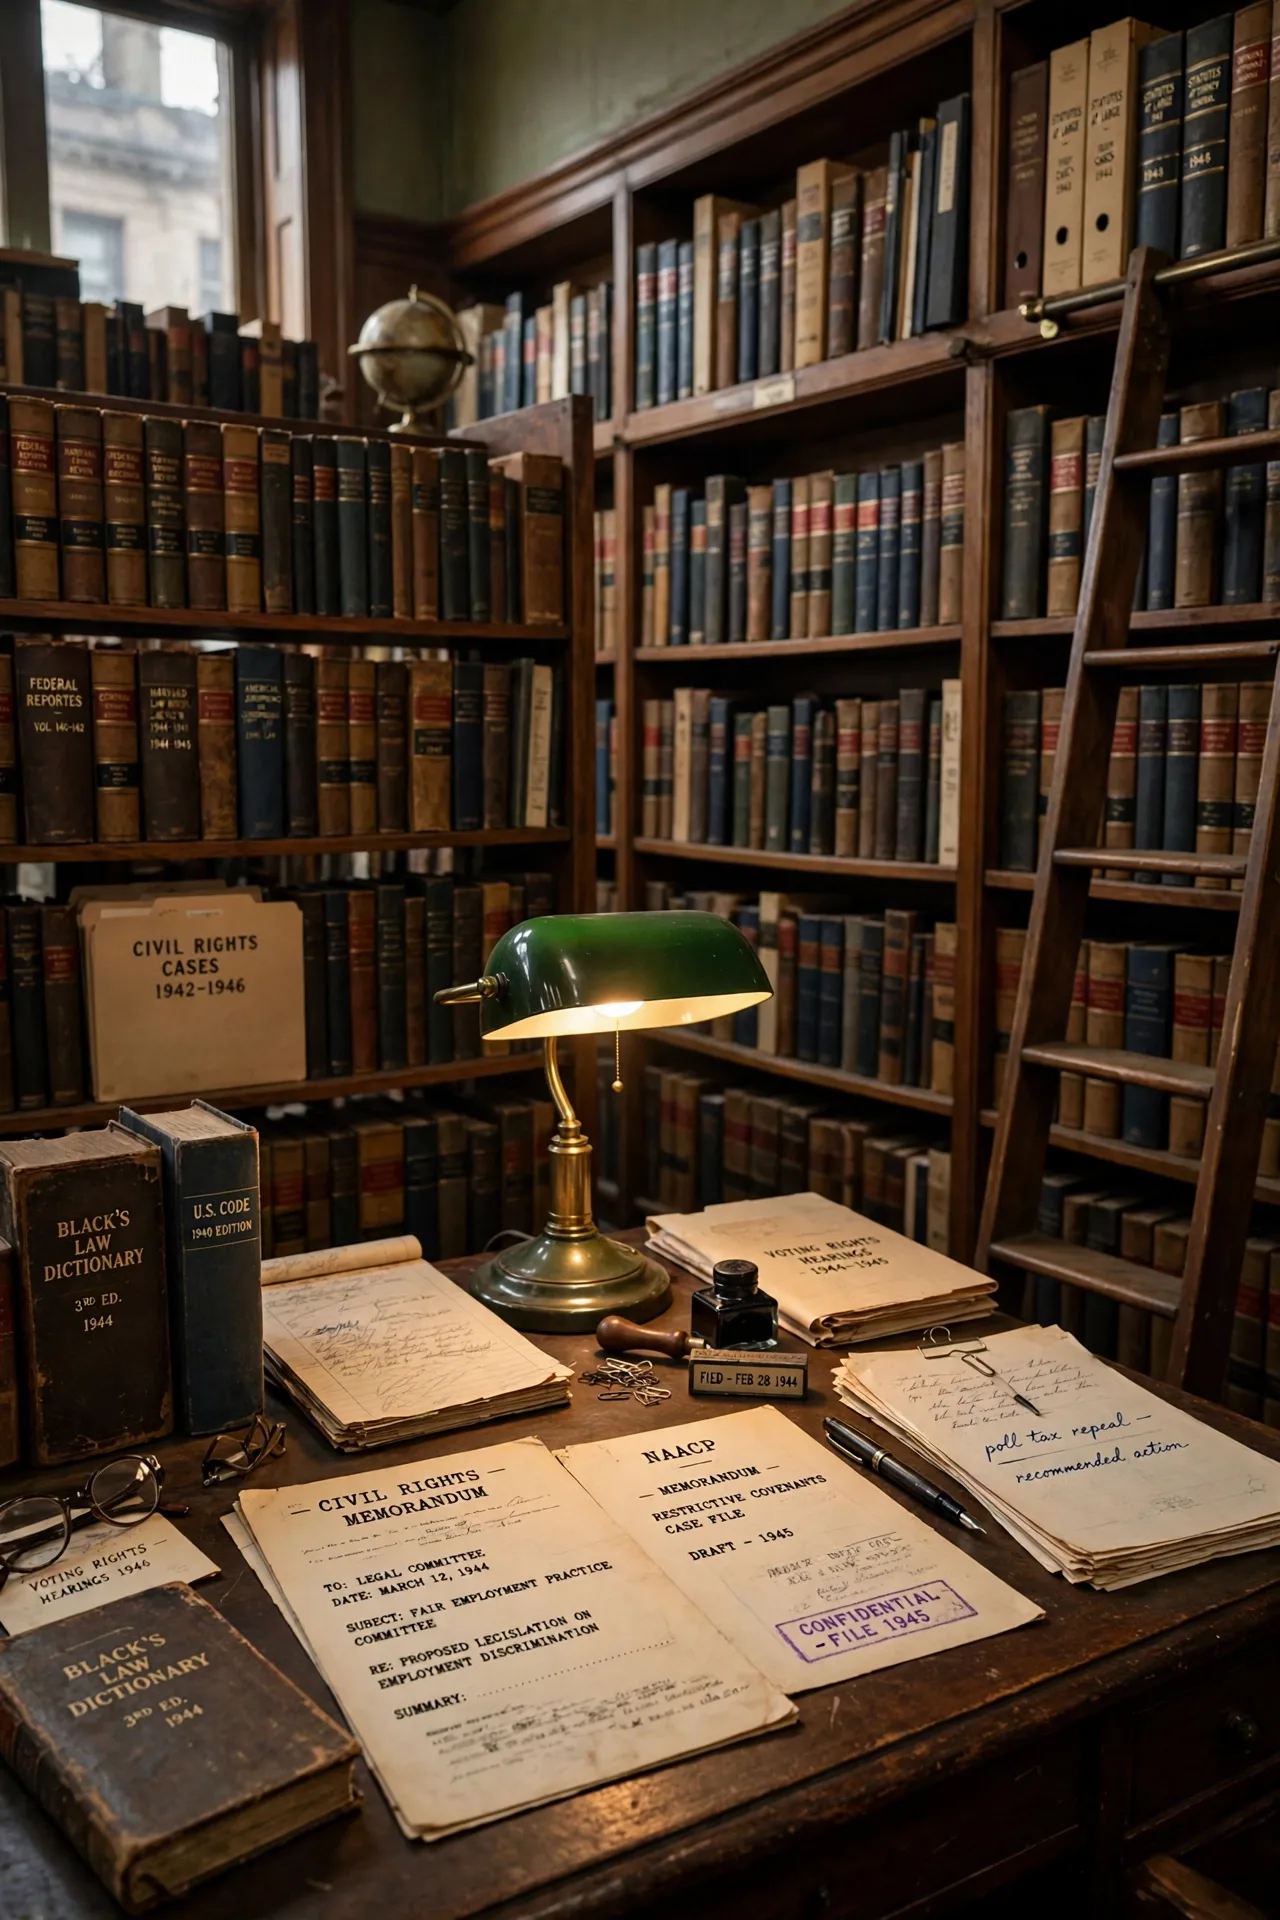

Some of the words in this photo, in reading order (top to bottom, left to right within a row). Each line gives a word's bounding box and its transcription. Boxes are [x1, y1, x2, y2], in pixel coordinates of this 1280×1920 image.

[30, 677, 78, 691] FEDERAL
[26, 694, 83, 707] REPORTES
[133, 939, 184, 957] CIVIL
[194, 935, 258, 954] RIGHTS
[162, 958, 219, 977] CASES
[155, 978, 246, 999] 1942-1946
[57, 1209, 130, 1238] BLACK'S
[194, 1203, 216, 1220] U.S.
[219, 1198, 250, 1215] CODE
[192, 1226, 213, 1239] 1940
[216, 1220, 252, 1237] EDITION
[74, 1234, 112, 1255] LAW
[764, 1244, 820, 1258] VOTING
[826, 1236, 880, 1250] RIGHTS
[798, 1249, 873, 1265] HEARINGS
[44, 1248, 144, 1282] DICTIONARY
[75, 1296, 96, 1312] 3RD
[101, 1292, 122, 1306] ED.
[84, 1314, 113, 1332] 1944
[735, 1372, 754, 1385] FEB
[757, 1374, 771, 1386] 28
[775, 1375, 798, 1387] 1944
[641, 1439, 716, 1464] NAACP
[985, 1432, 1022, 1462] poll
[1026, 1430, 1062, 1442] tax
[1072, 1412, 1131, 1440] repeal
[1016, 1447, 1126, 1483] recommended
[1133, 1441, 1189, 1458] action
[319, 1489, 387, 1512] CIVIL
[397, 1469, 480, 1496] RIGHTS
[657, 1466, 761, 1496] MEMORANDUM
[342, 1486, 489, 1526] MEMORANDUM
[652, 1493, 746, 1521] RESTRICTIVE
[750, 1474, 827, 1498] COVENANTS
[665, 1519, 703, 1534] CASE
[708, 1509, 746, 1524] FILE
[688, 1541, 736, 1561] DRAFT
[759, 1528, 794, 1543] 1945
[28, 1566, 84, 1592] VOTING
[92, 1543, 148, 1569] RIGHTS
[323, 1582, 347, 1593] TO:
[356, 1569, 402, 1586] LEGAL
[408, 1549, 486, 1572] COMMITTEE
[40, 1574, 110, 1604] HEARINGS
[332, 1591, 373, 1607] DATE:
[378, 1577, 425, 1596] MARCH
[431, 1573, 452, 1583] 12,
[458, 1563, 490, 1577] 1944
[346, 1612, 404, 1633] SUBECT:
[409, 1602, 446, 1618] FAIR
[451, 1579, 538, 1608] EMPLOYMENT
[545, 1561, 613, 1584] PRACTICE
[799, 1589, 940, 1636] CONFIDENTIAL
[883, 1610, 930, 1631] 1945
[354, 1619, 437, 1646] COMMITTEE
[369, 1661, 394, 1675] RE:
[400, 1641, 469, 1667] PROPOSED
[574, 1609, 592, 1621] ON
[62, 1633, 167, 1681] BLACK'S
[378, 1657, 473, 1689] EMPLOYMENT
[480, 1622, 600, 1663] DISCRIMINATION
[67, 1652, 211, 1718] DICTIONARY
[99, 1656, 150, 1685] LAW
[123, 1707, 153, 1728] 3RD
[158, 1695, 188, 1711] ED.
[165, 1703, 204, 1728] 1944
[394, 1693, 467, 1720] SUMMARY:
